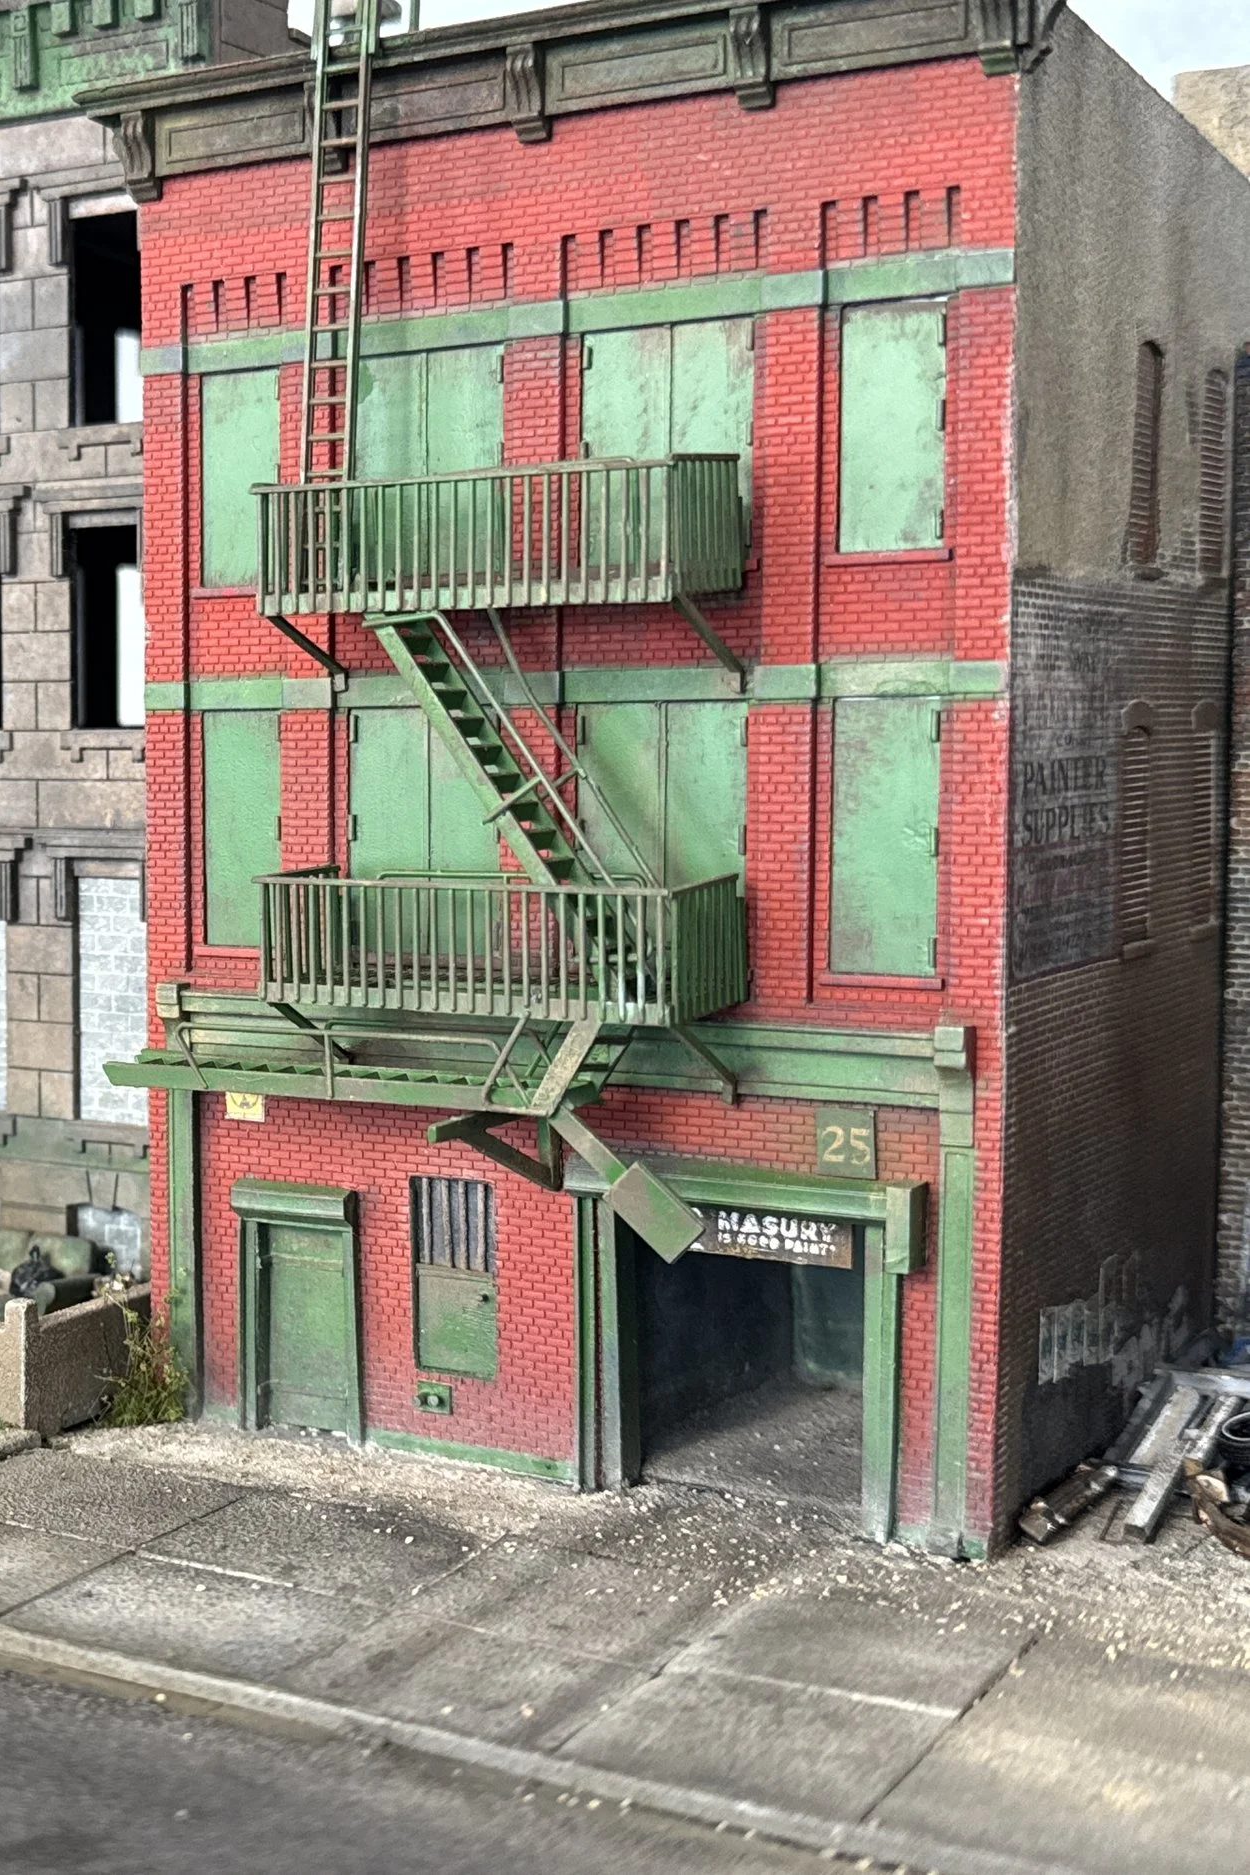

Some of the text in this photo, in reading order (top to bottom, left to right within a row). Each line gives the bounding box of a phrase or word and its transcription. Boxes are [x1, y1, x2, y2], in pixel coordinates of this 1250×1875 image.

[1022, 802, 1109, 846] SUPPLIES
[821, 1125, 871, 1165] 25
[717, 1210, 838, 1243] MASURY
